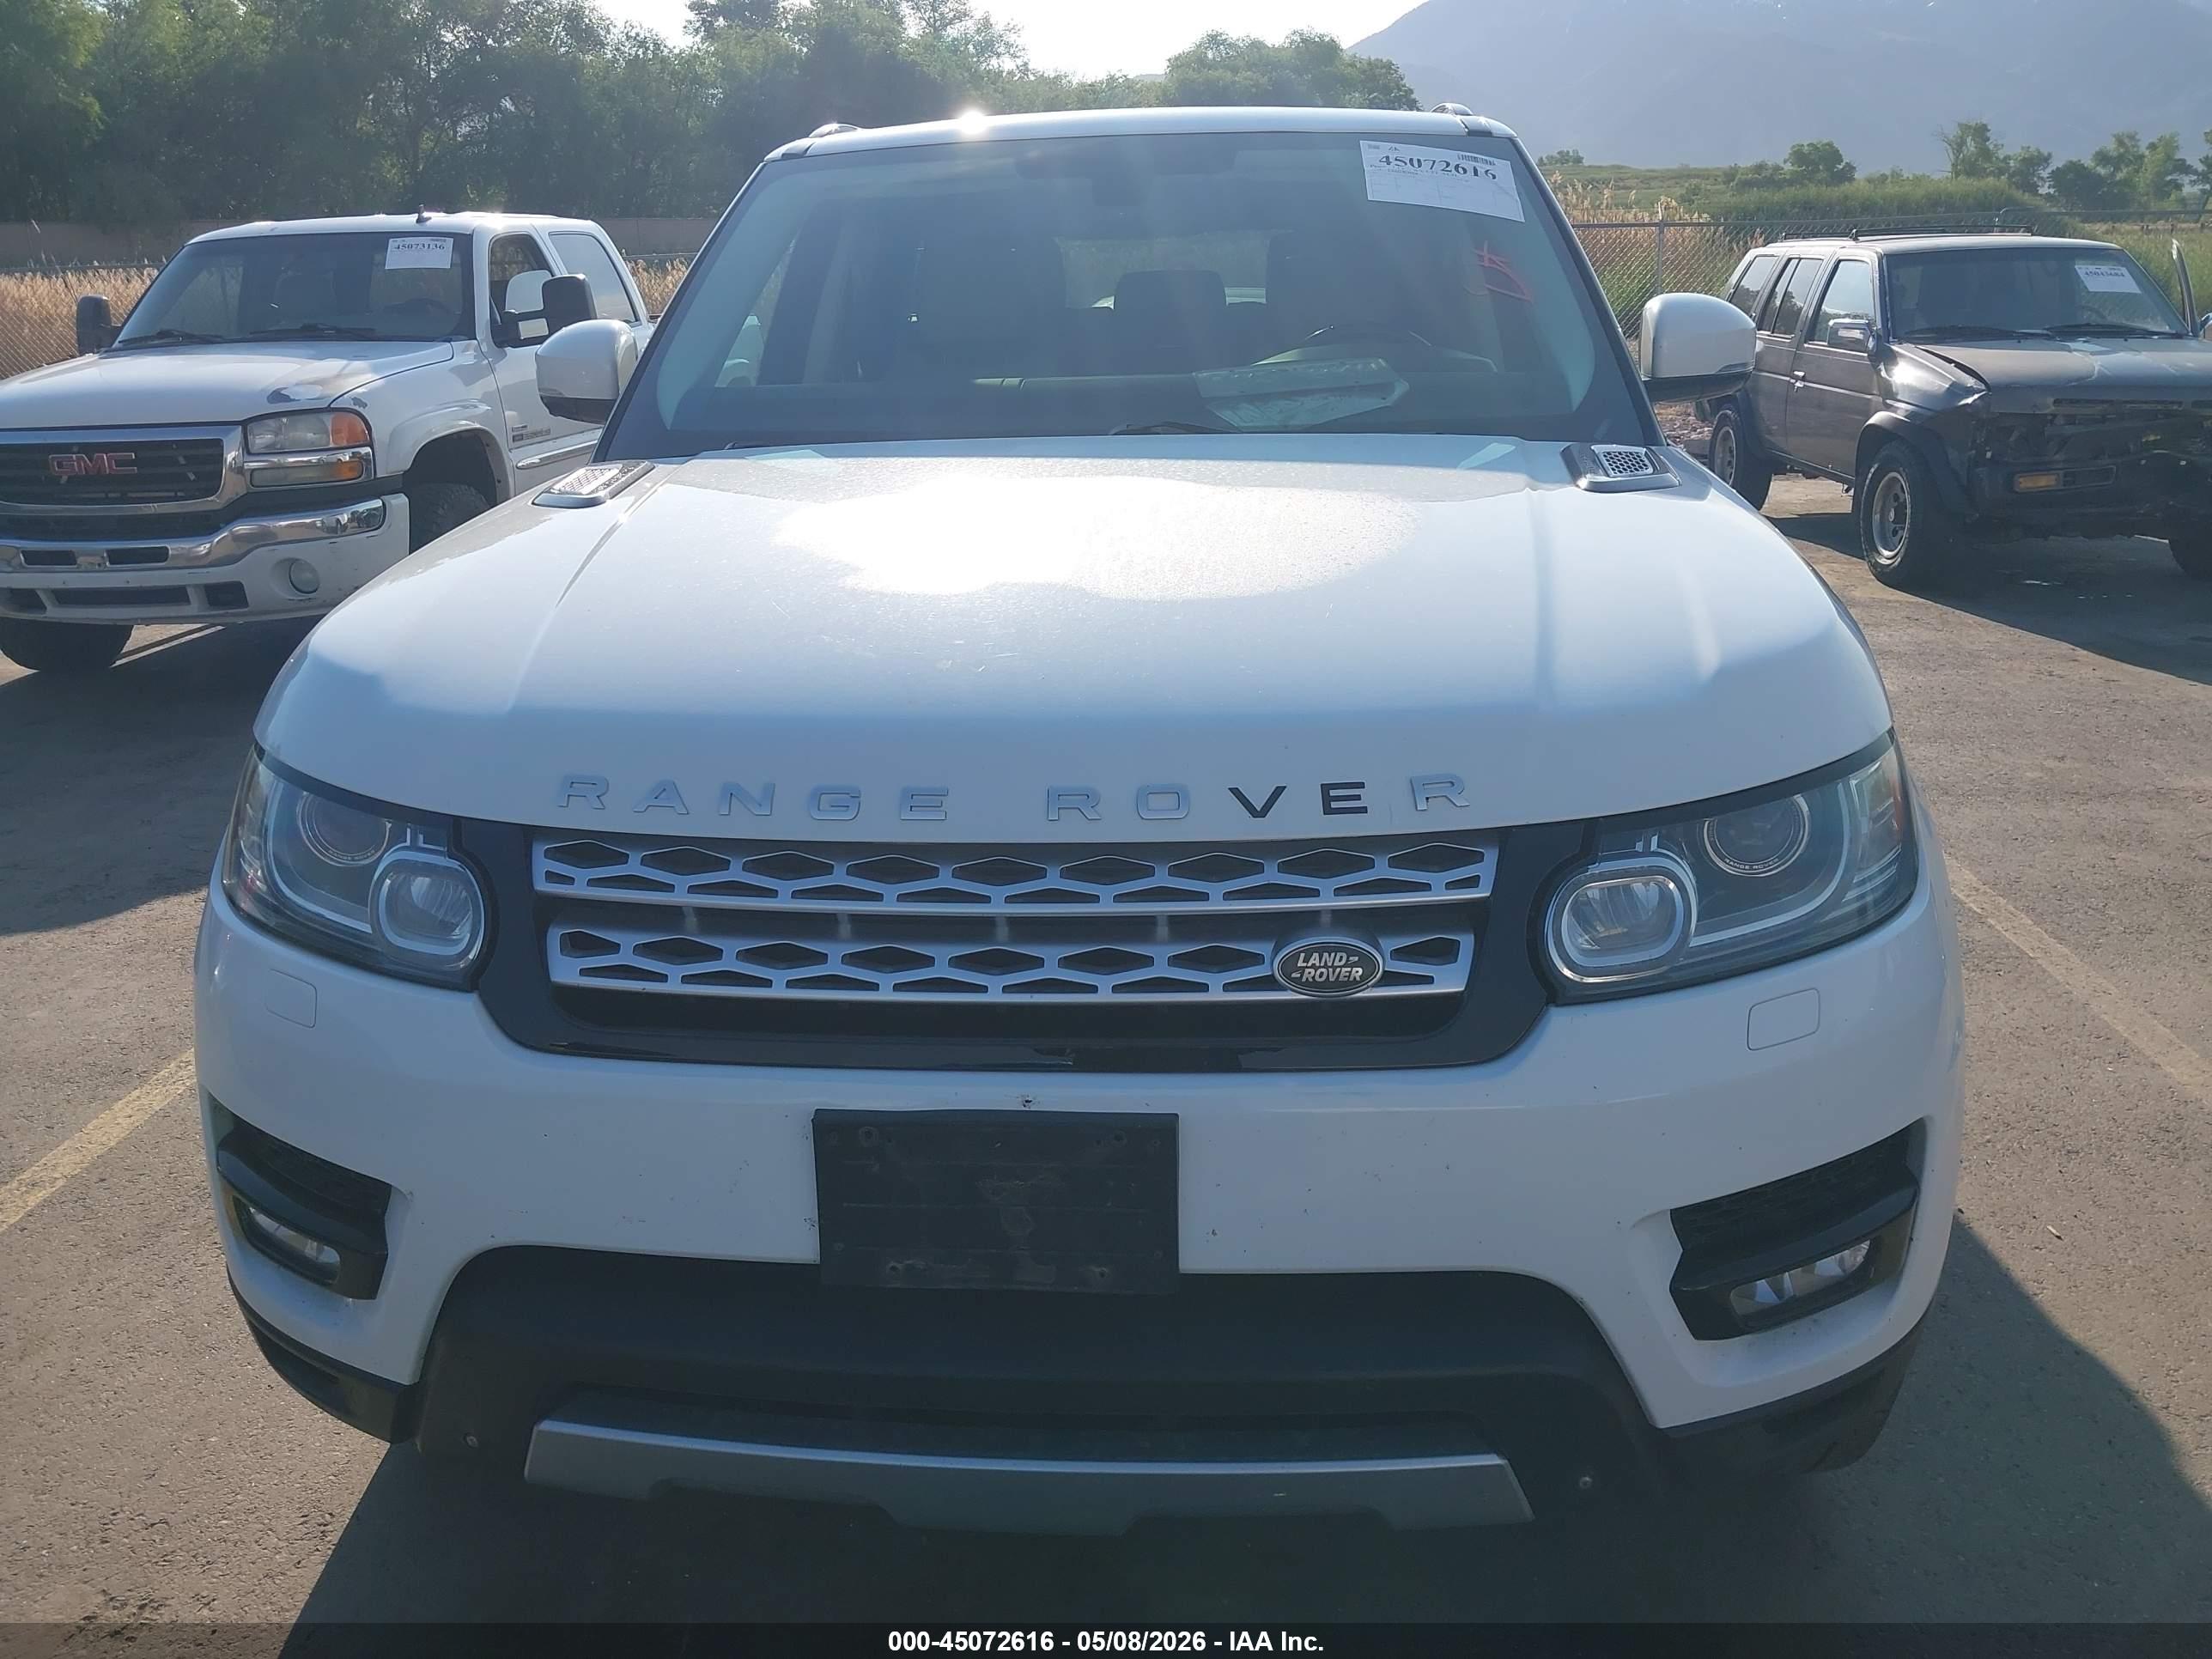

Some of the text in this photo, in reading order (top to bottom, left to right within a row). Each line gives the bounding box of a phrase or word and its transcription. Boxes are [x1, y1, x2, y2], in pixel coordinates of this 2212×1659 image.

[49, 453, 137, 475] GMC
[557, 774, 1471, 822] RANGE ROVER
[1724, 858, 1750, 870] RANGE
[1297, 952, 1347, 967] LAND
[1302, 968, 1364, 982] ROVER
